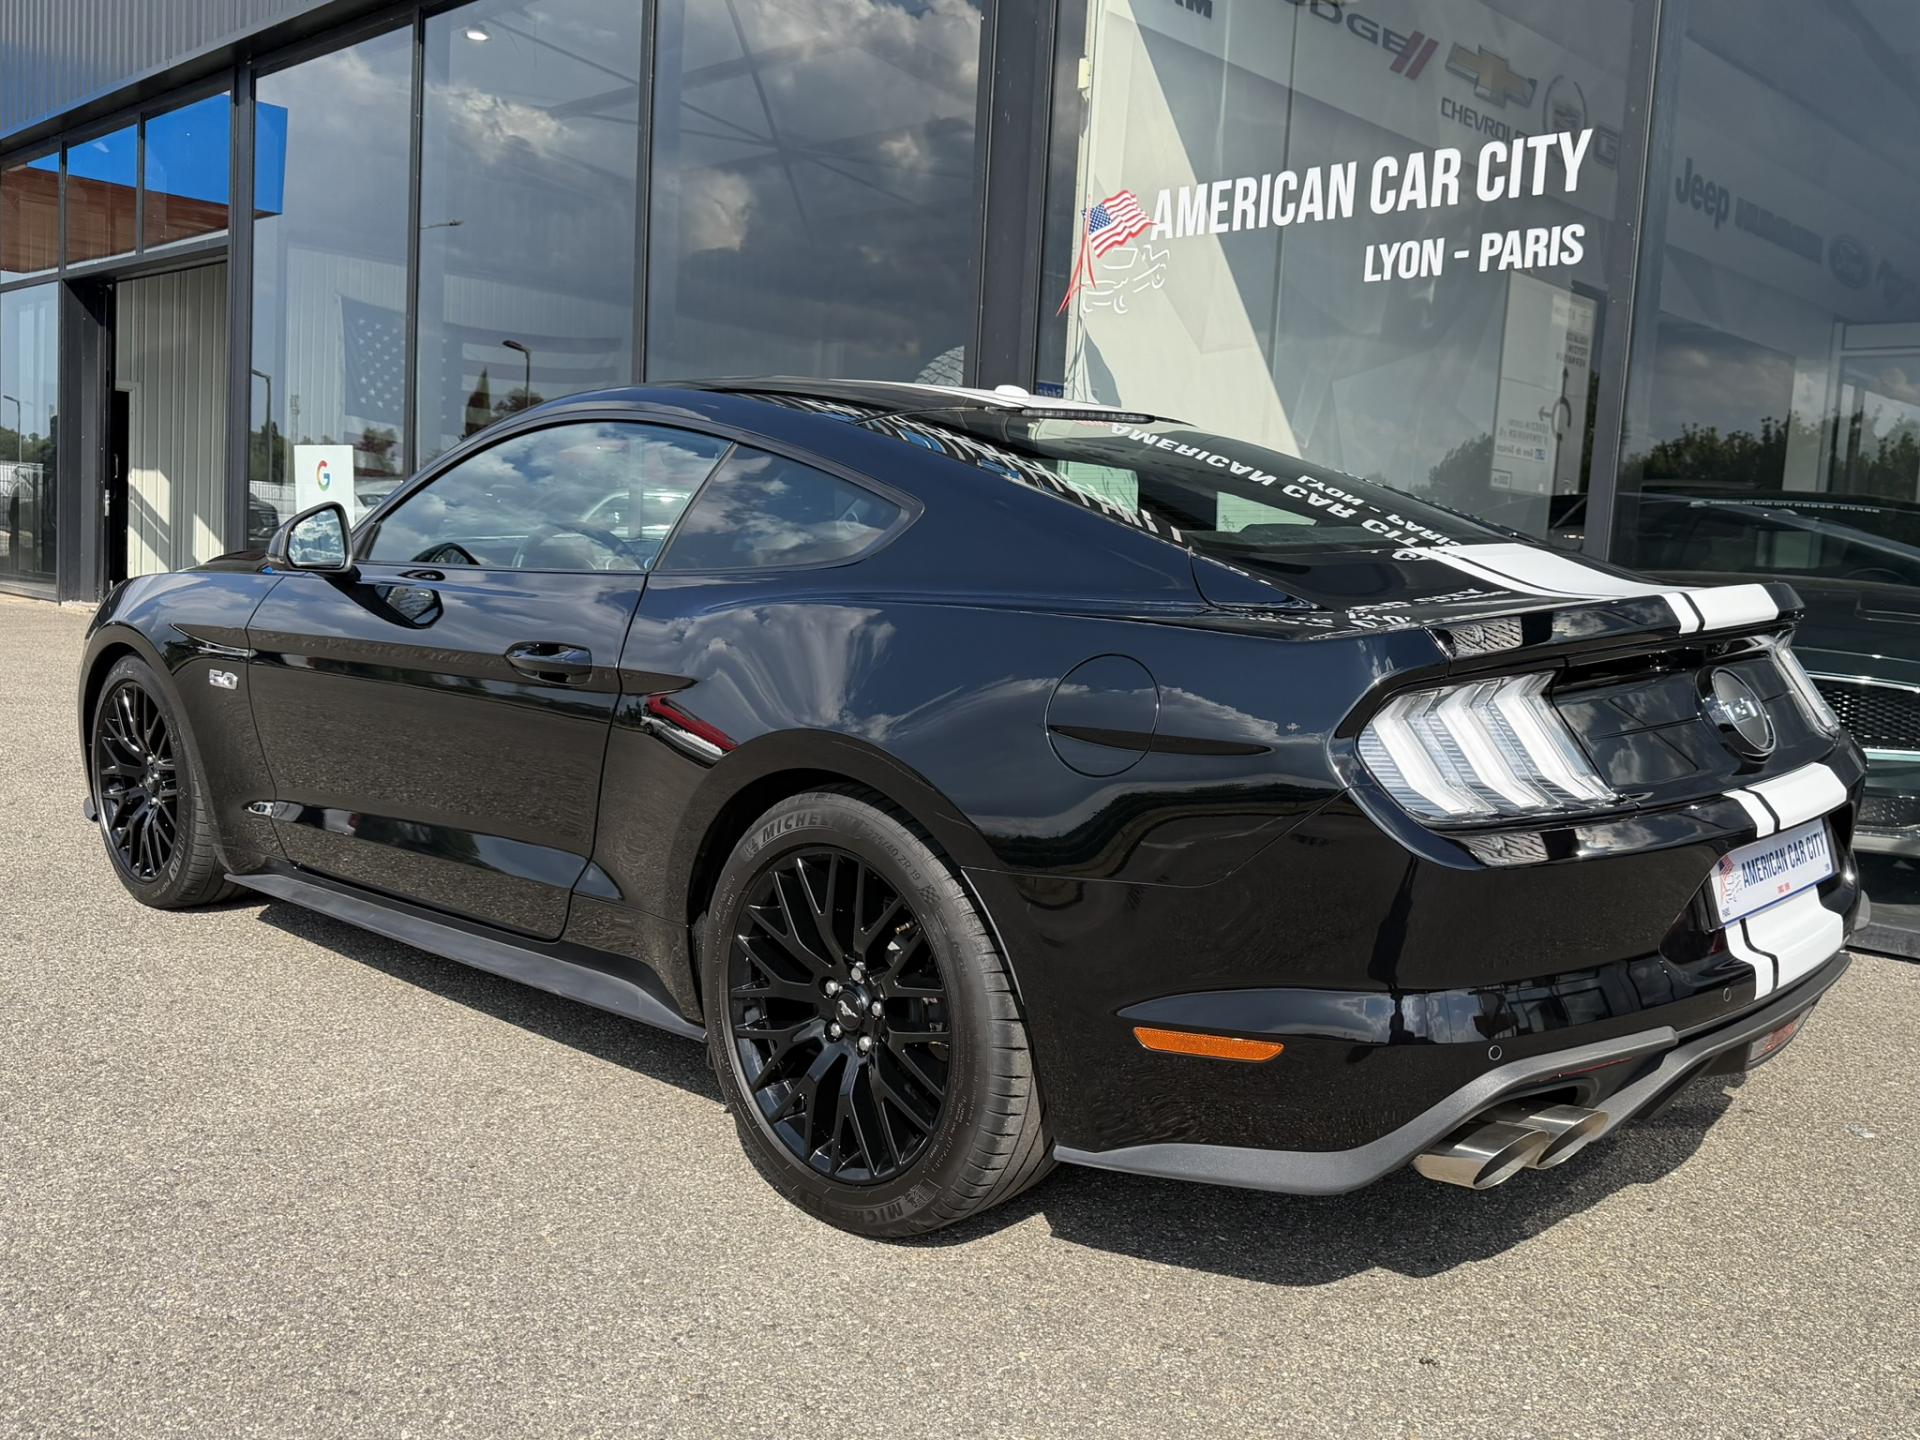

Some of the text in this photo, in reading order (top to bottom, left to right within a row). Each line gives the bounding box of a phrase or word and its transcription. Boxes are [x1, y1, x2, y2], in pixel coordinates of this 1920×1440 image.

[1441, 97, 1530, 144] CHEVROL
[1150, 161, 1357, 241] AMERICAN
[1370, 148, 1461, 215] CAR
[1477, 129, 1593, 202] CITY
[1675, 157, 1730, 231] Jeep
[1363, 238, 1444, 282] LYON
[1478, 224, 1585, 272] PARIS
[316, 460, 331, 491] G
[1741, 831, 1826, 888] AMERICAN CAR CITY
